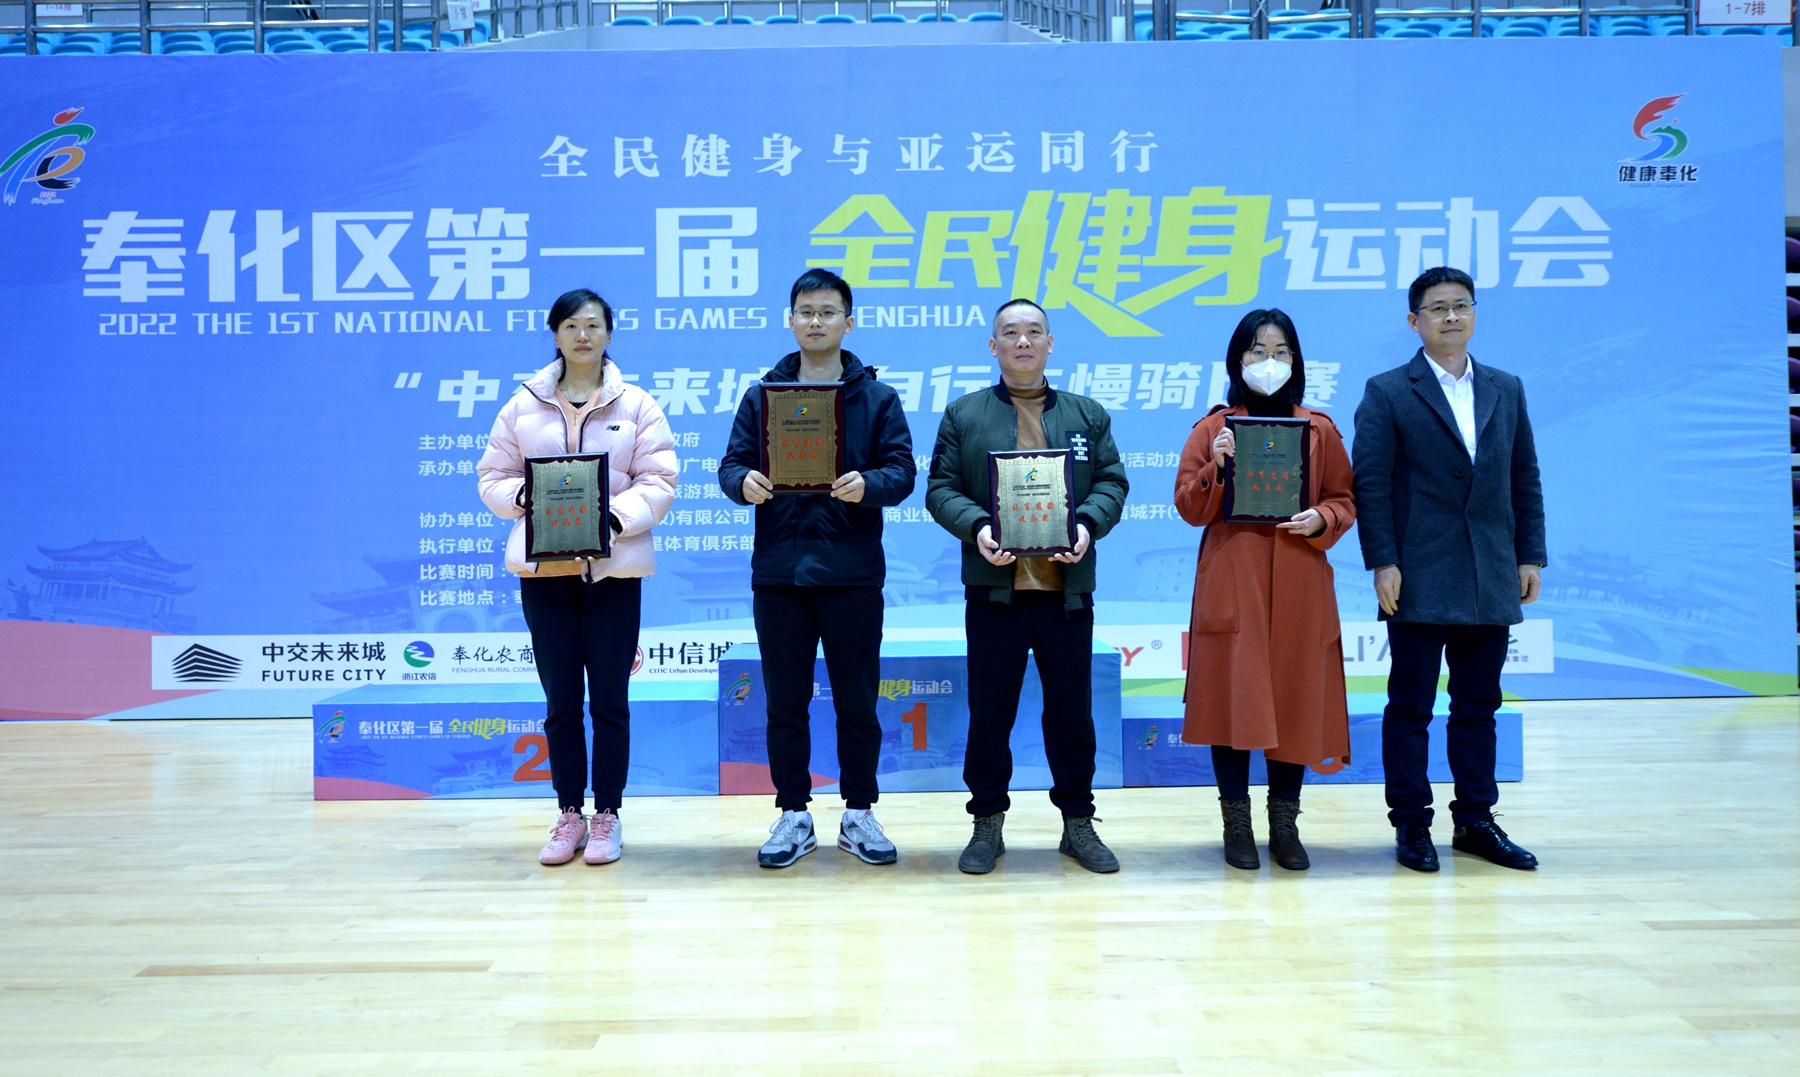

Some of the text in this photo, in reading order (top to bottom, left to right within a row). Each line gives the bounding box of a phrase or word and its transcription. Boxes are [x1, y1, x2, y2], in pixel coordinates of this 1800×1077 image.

[539, 129, 1157, 178] 全民健身与亚运同行
[1618, 165, 1698, 182] 健康奉化
[82, 207, 759, 302] 奉化区第一届
[100, 313, 176, 336] 2022
[192, 313, 252, 335] THE
[268, 312, 319, 334] 1ST
[335, 310, 491, 333] NATIONAL
[507, 308, 639, 332] FITS
[655, 307, 767, 330] GAMES
[852, 305, 987, 328] ENGHUA
[419, 460, 479, 476] 承办单
[262, 641, 386, 662] 中交未来城
[262, 669, 386, 681] FUTURE CITY
[359, 721, 443, 735] 奉化区第一届
[902, 702, 927, 750] 1
[513, 734, 552, 782] 2
